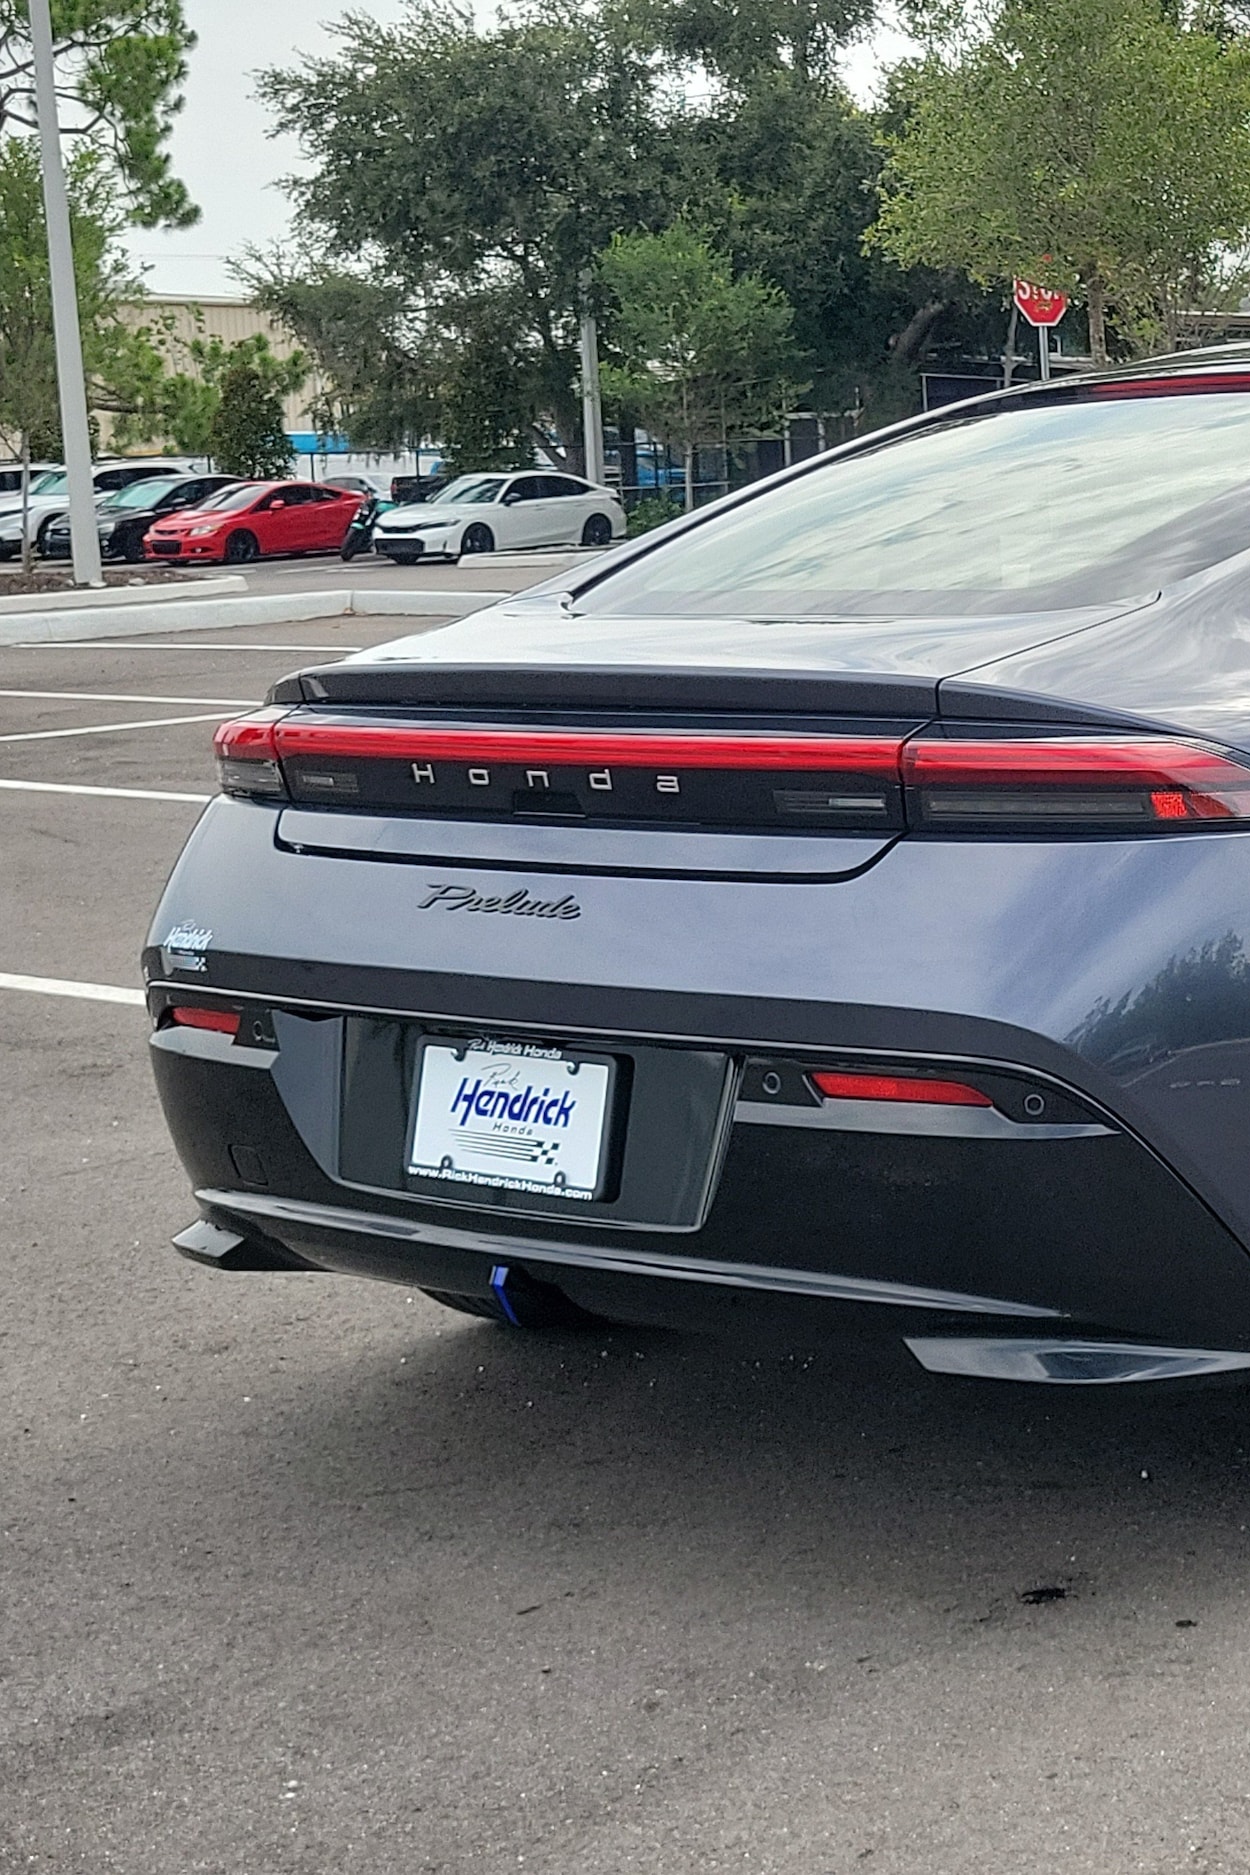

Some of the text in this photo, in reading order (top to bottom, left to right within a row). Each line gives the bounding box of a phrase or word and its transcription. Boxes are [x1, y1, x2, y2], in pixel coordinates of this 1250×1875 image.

[411, 763, 680, 793] Honda
[416, 883, 582, 920] Prelude
[523, 1044, 562, 1059] Honda
[451, 1077, 576, 1128] Hendrick
[492, 1122, 533, 1136] Honda
[408, 1165, 592, 1200] www.RickHendrickHonda.com
